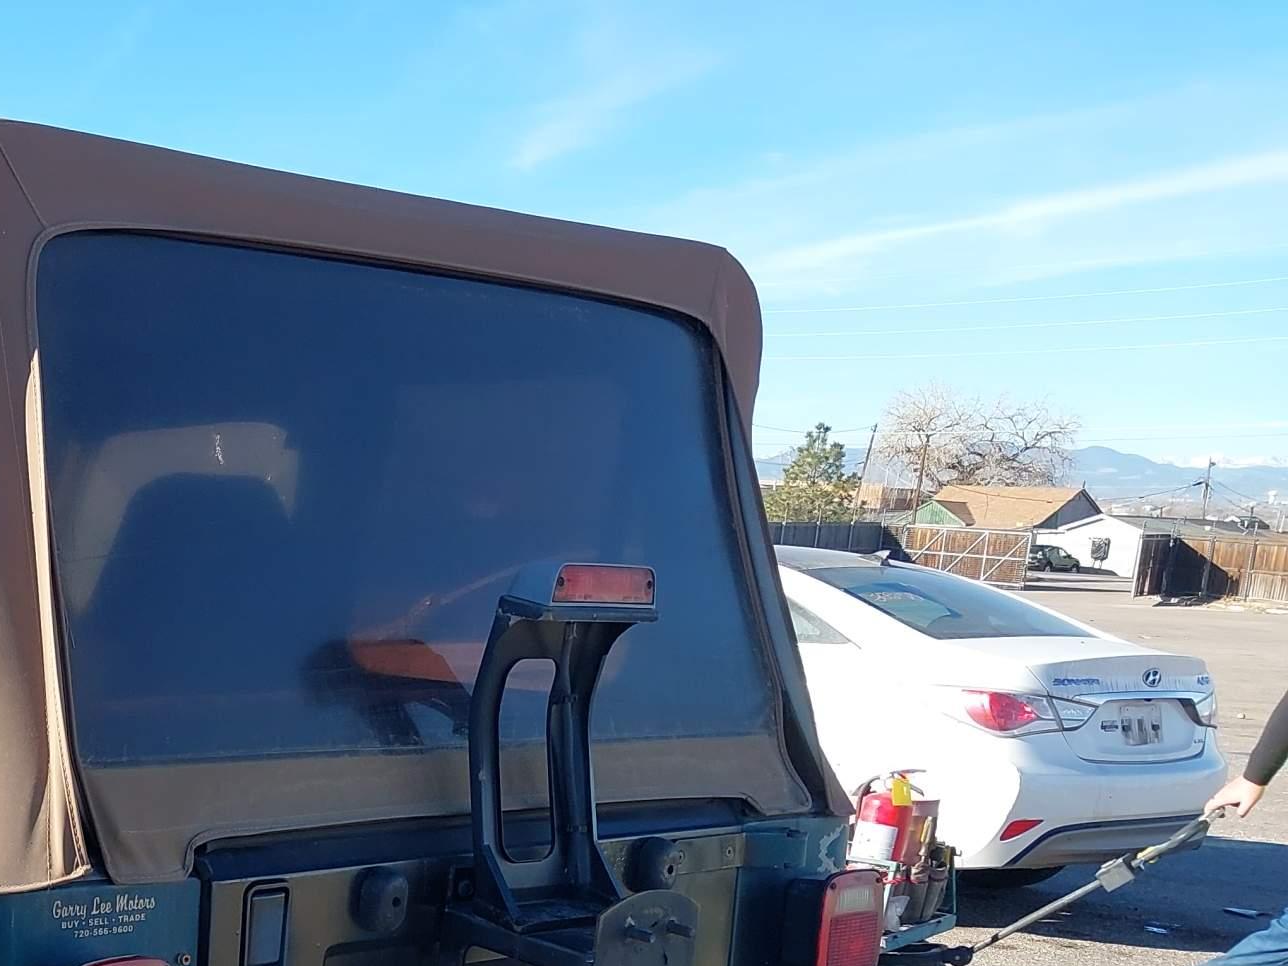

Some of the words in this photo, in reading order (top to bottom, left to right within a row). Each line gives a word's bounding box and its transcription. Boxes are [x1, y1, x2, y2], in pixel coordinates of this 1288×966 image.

[52, 900, 87, 919] Garry
[91, 897, 113, 915] Lee
[116, 894, 155, 913] Motors
[61, 920, 79, 929] BUY
[88, 917, 109, 926] SELL
[118, 913, 146, 923] TRADE
